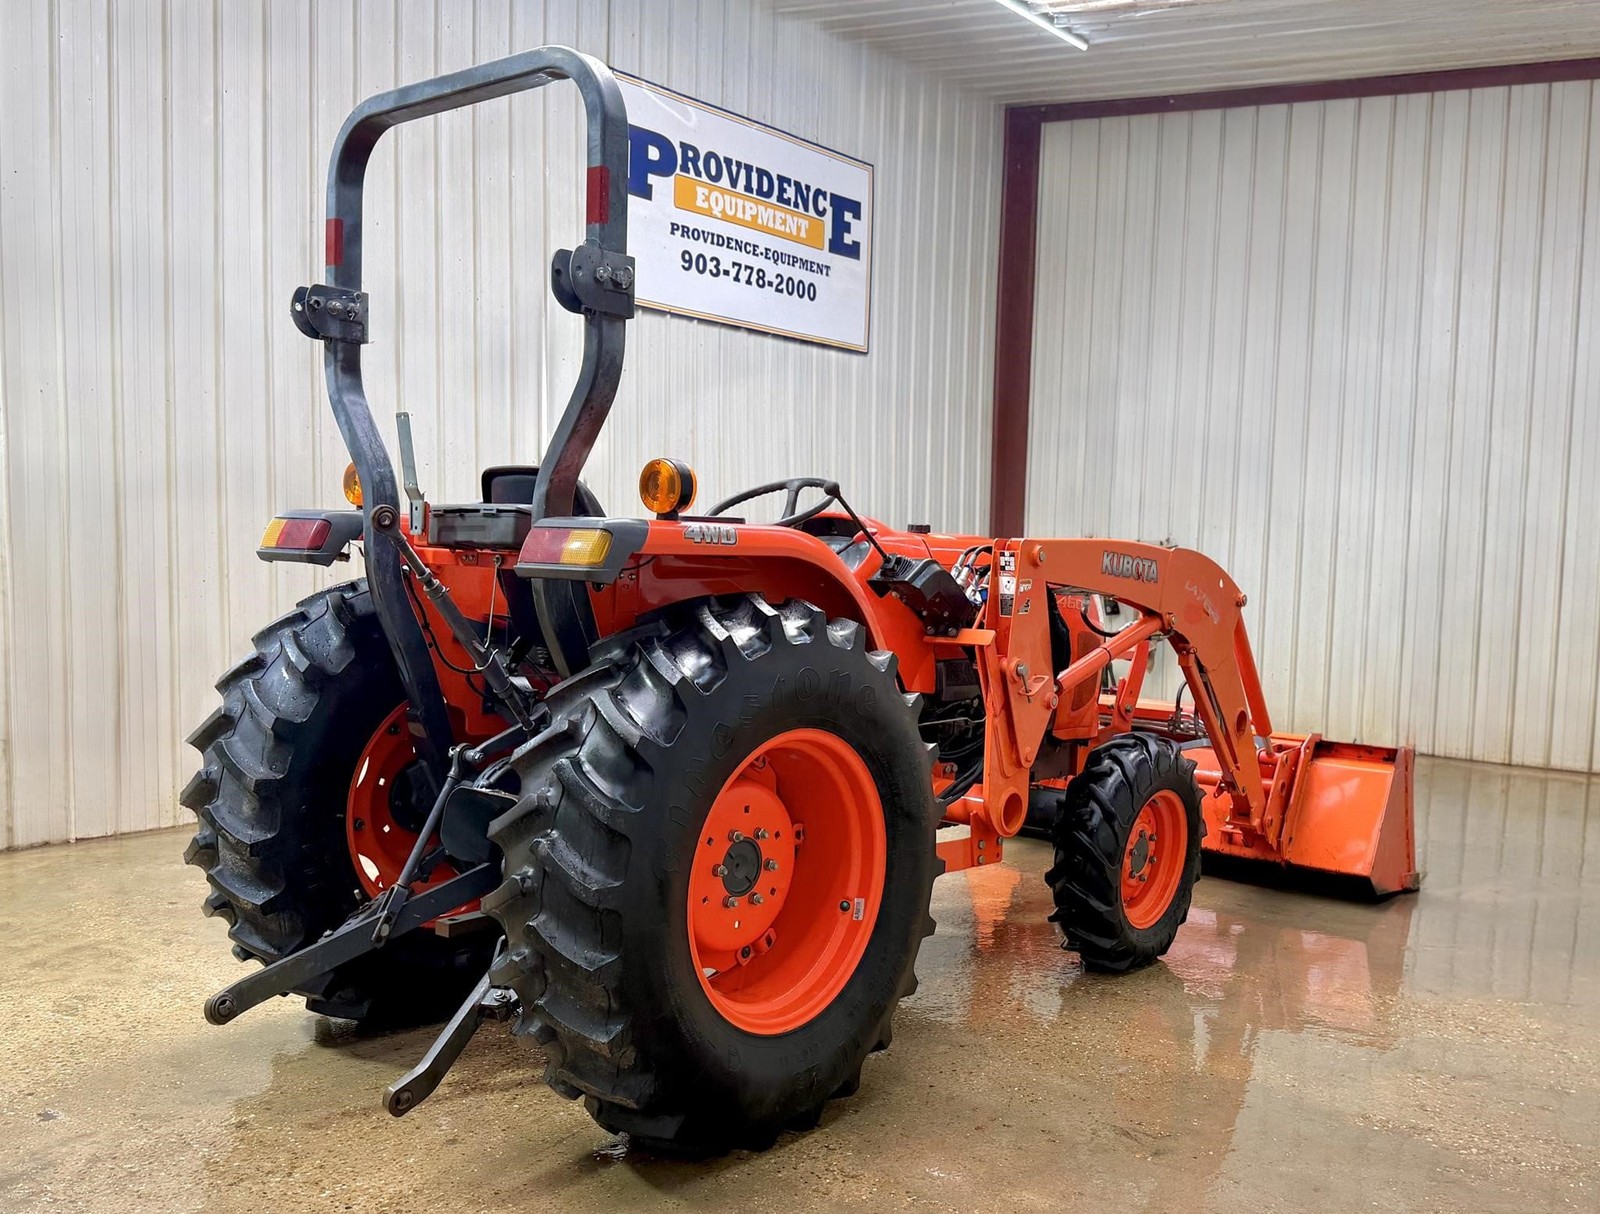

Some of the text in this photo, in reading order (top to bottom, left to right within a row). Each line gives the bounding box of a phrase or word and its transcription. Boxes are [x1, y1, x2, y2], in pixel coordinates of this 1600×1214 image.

[628, 124, 862, 261] PROVIDENCE
[695, 185, 809, 240] EQUIPMENT
[669, 222, 832, 278] PROVIDENCE-EQUIPMENT
[680, 249, 817, 302] 903-778-2000
[684, 525, 738, 546] 4WD
[1102, 550, 1158, 584] KUBOTA
